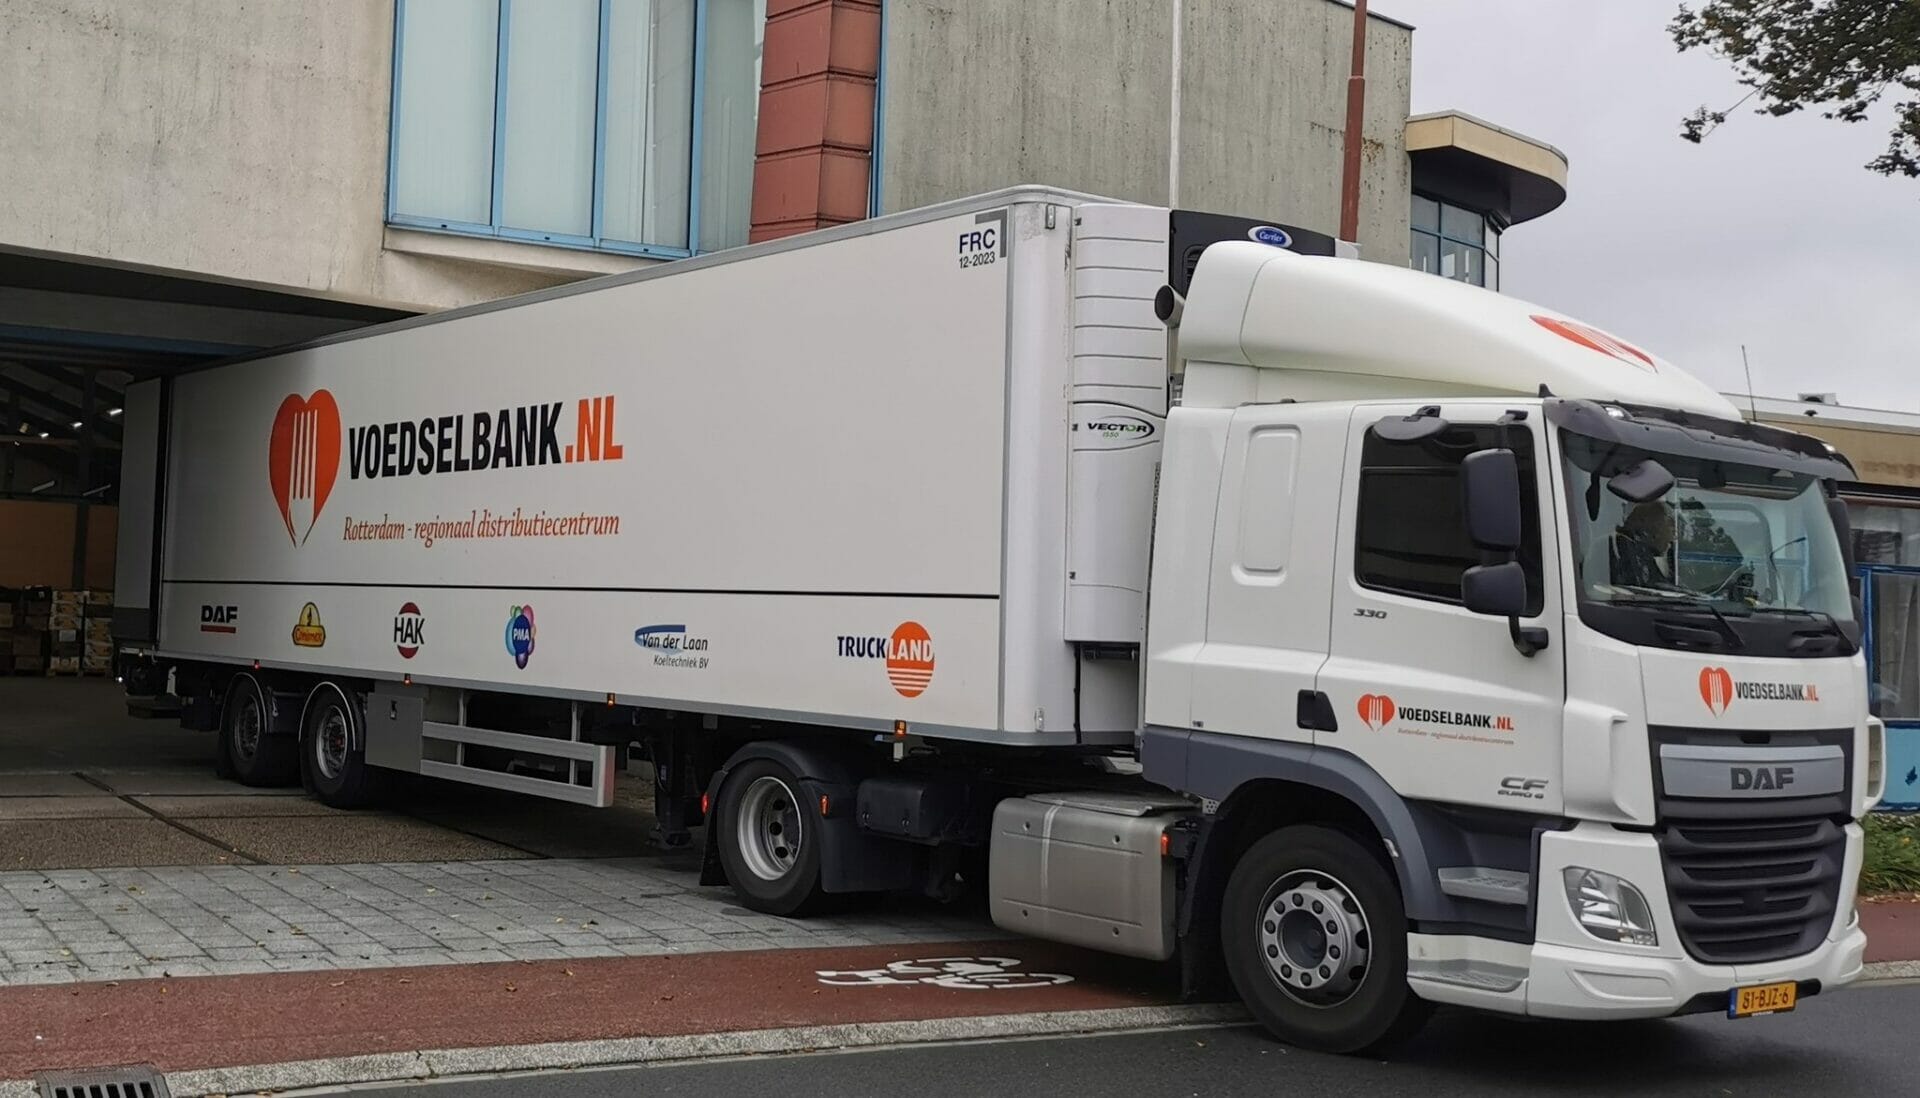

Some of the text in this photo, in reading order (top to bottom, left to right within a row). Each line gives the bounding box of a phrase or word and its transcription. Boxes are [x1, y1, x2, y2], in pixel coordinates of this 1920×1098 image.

[959, 228, 996, 254] FRC
[1259, 231, 1283, 242] Carrier
[959, 251, 996, 269] 12-2023
[1087, 422, 1148, 433] VECTOR
[349, 395, 624, 480] VOEDSELBANK.NL
[343, 514, 405, 541] Rotterdam
[414, 510, 477, 549] regionaal
[477, 508, 620, 538] distributiecentrum
[201, 605, 239, 624] DAF
[1353, 608, 1388, 620] 330
[394, 617, 426, 645] HAK
[513, 628, 530, 641] PMA
[642, 633, 709, 651] Van der Laan
[653, 654, 710, 669] Koeltechniek BV
[1735, 681, 1820, 702] VOEDSELBANK.NL
[1398, 706, 1515, 732] VOEDSELBANK.NL
[1501, 777, 1550, 790] CF
[1730, 767, 1795, 791] DAF
